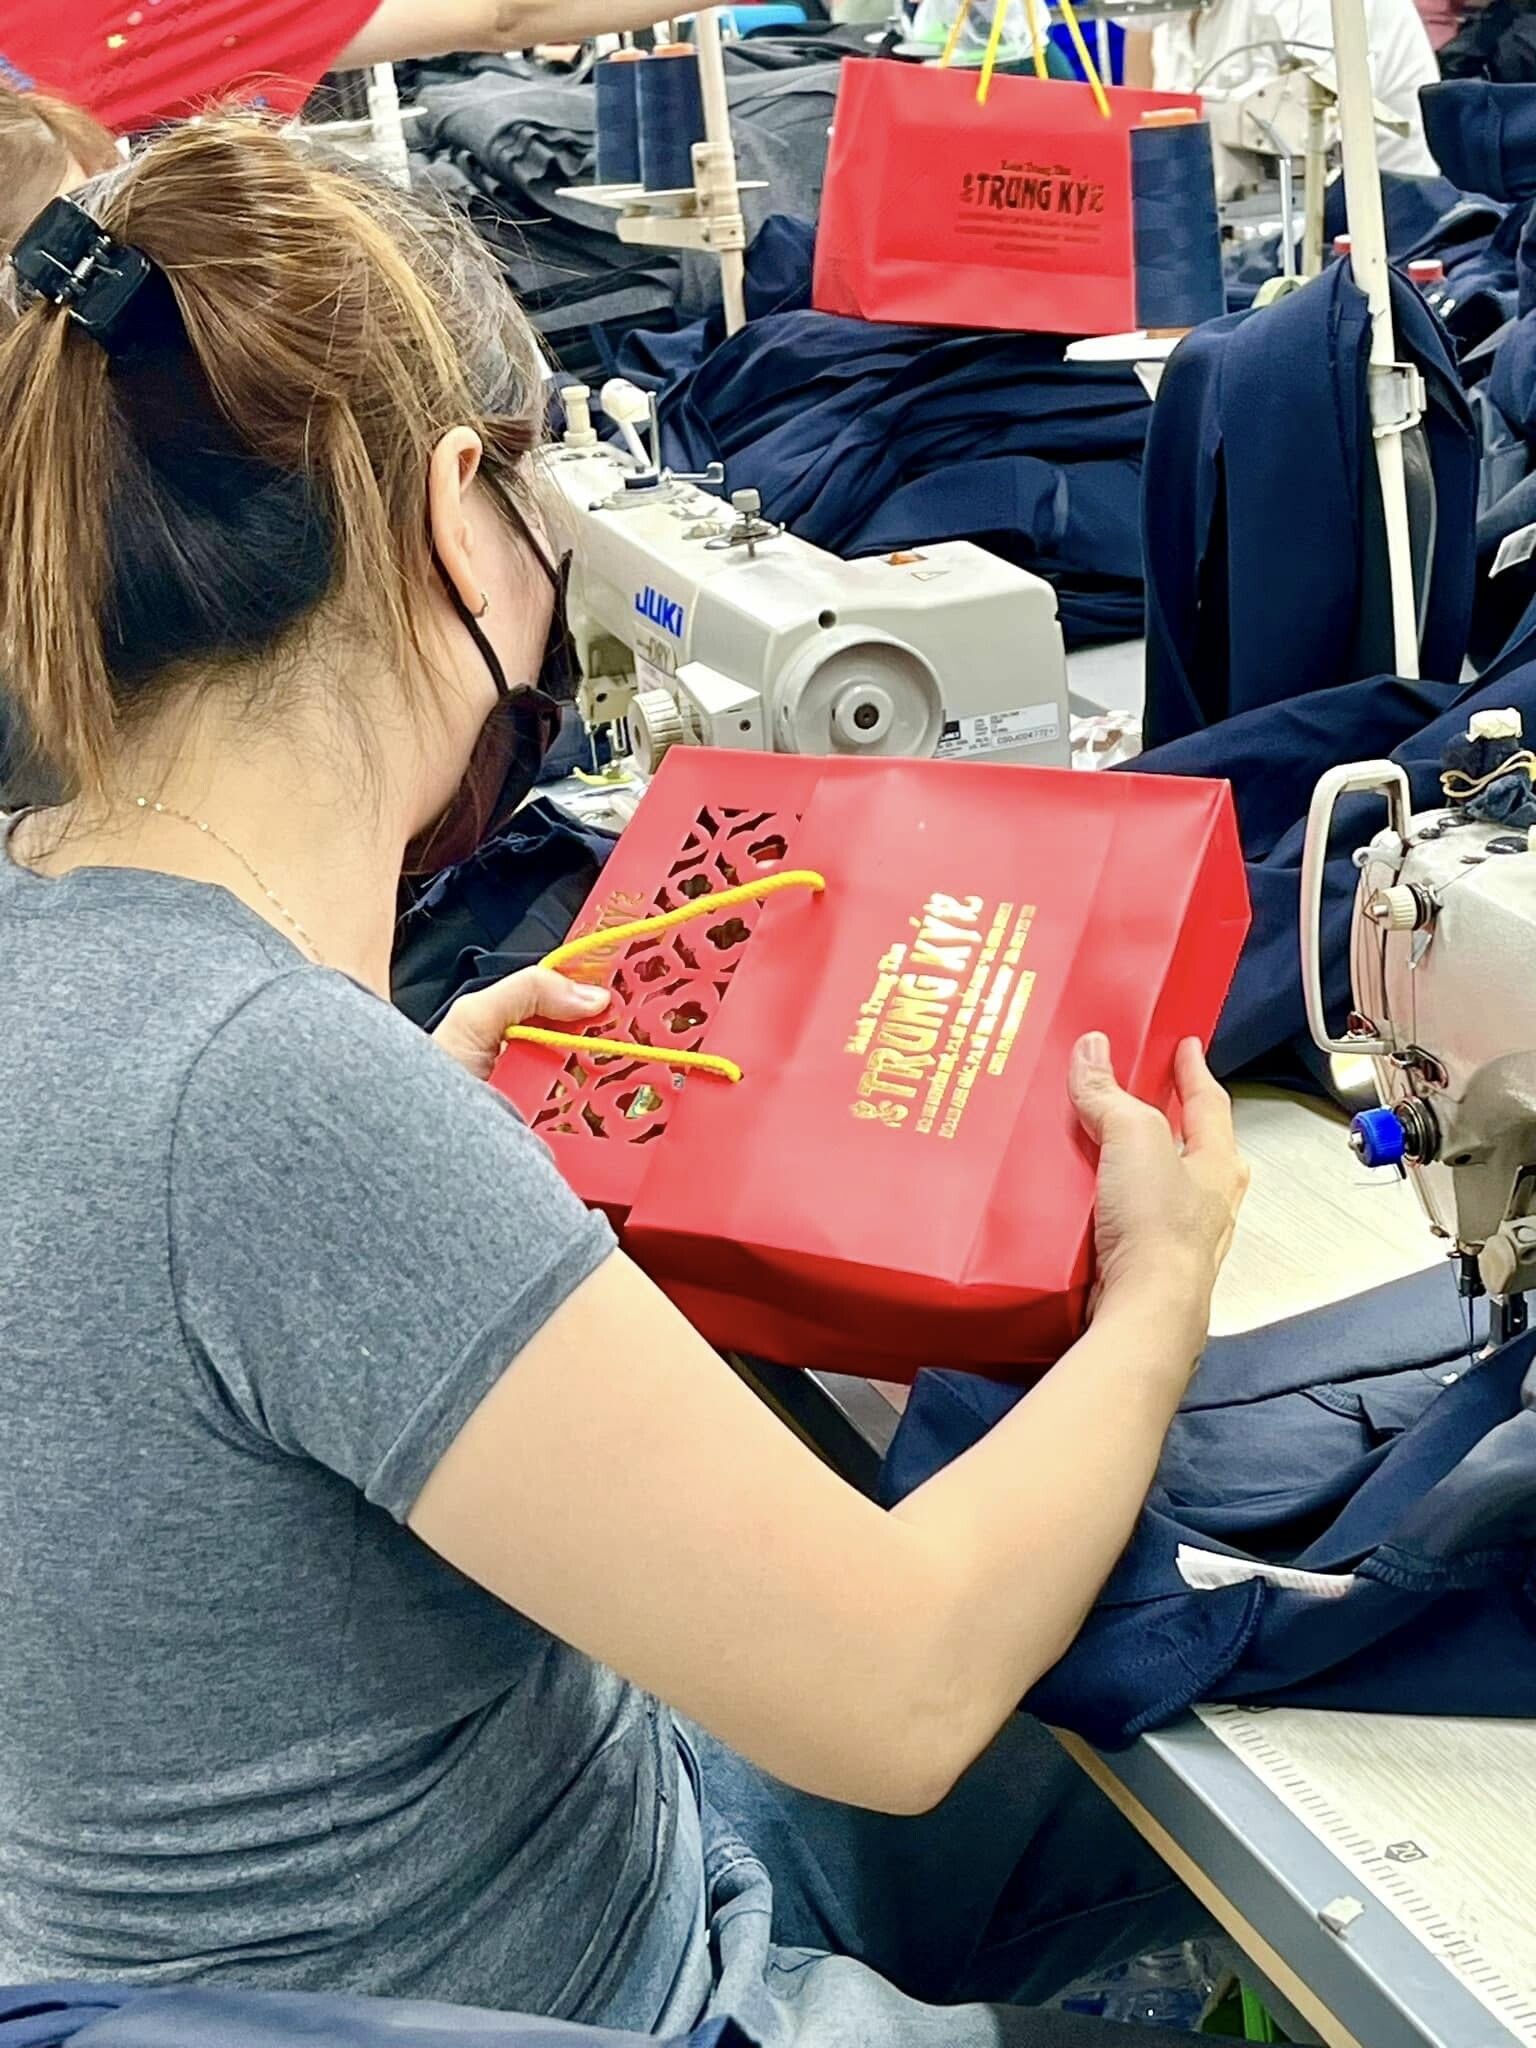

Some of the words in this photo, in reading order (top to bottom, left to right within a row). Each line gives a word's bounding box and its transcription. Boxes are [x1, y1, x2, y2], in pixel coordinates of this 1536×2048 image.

[977, 173, 1052, 211] TRUNG
[635, 585, 684, 639] JUKI
[856, 972, 960, 1097] TRUNG
[908, 914, 983, 972] KÝ
[1390, 1842, 1423, 1861] 20
